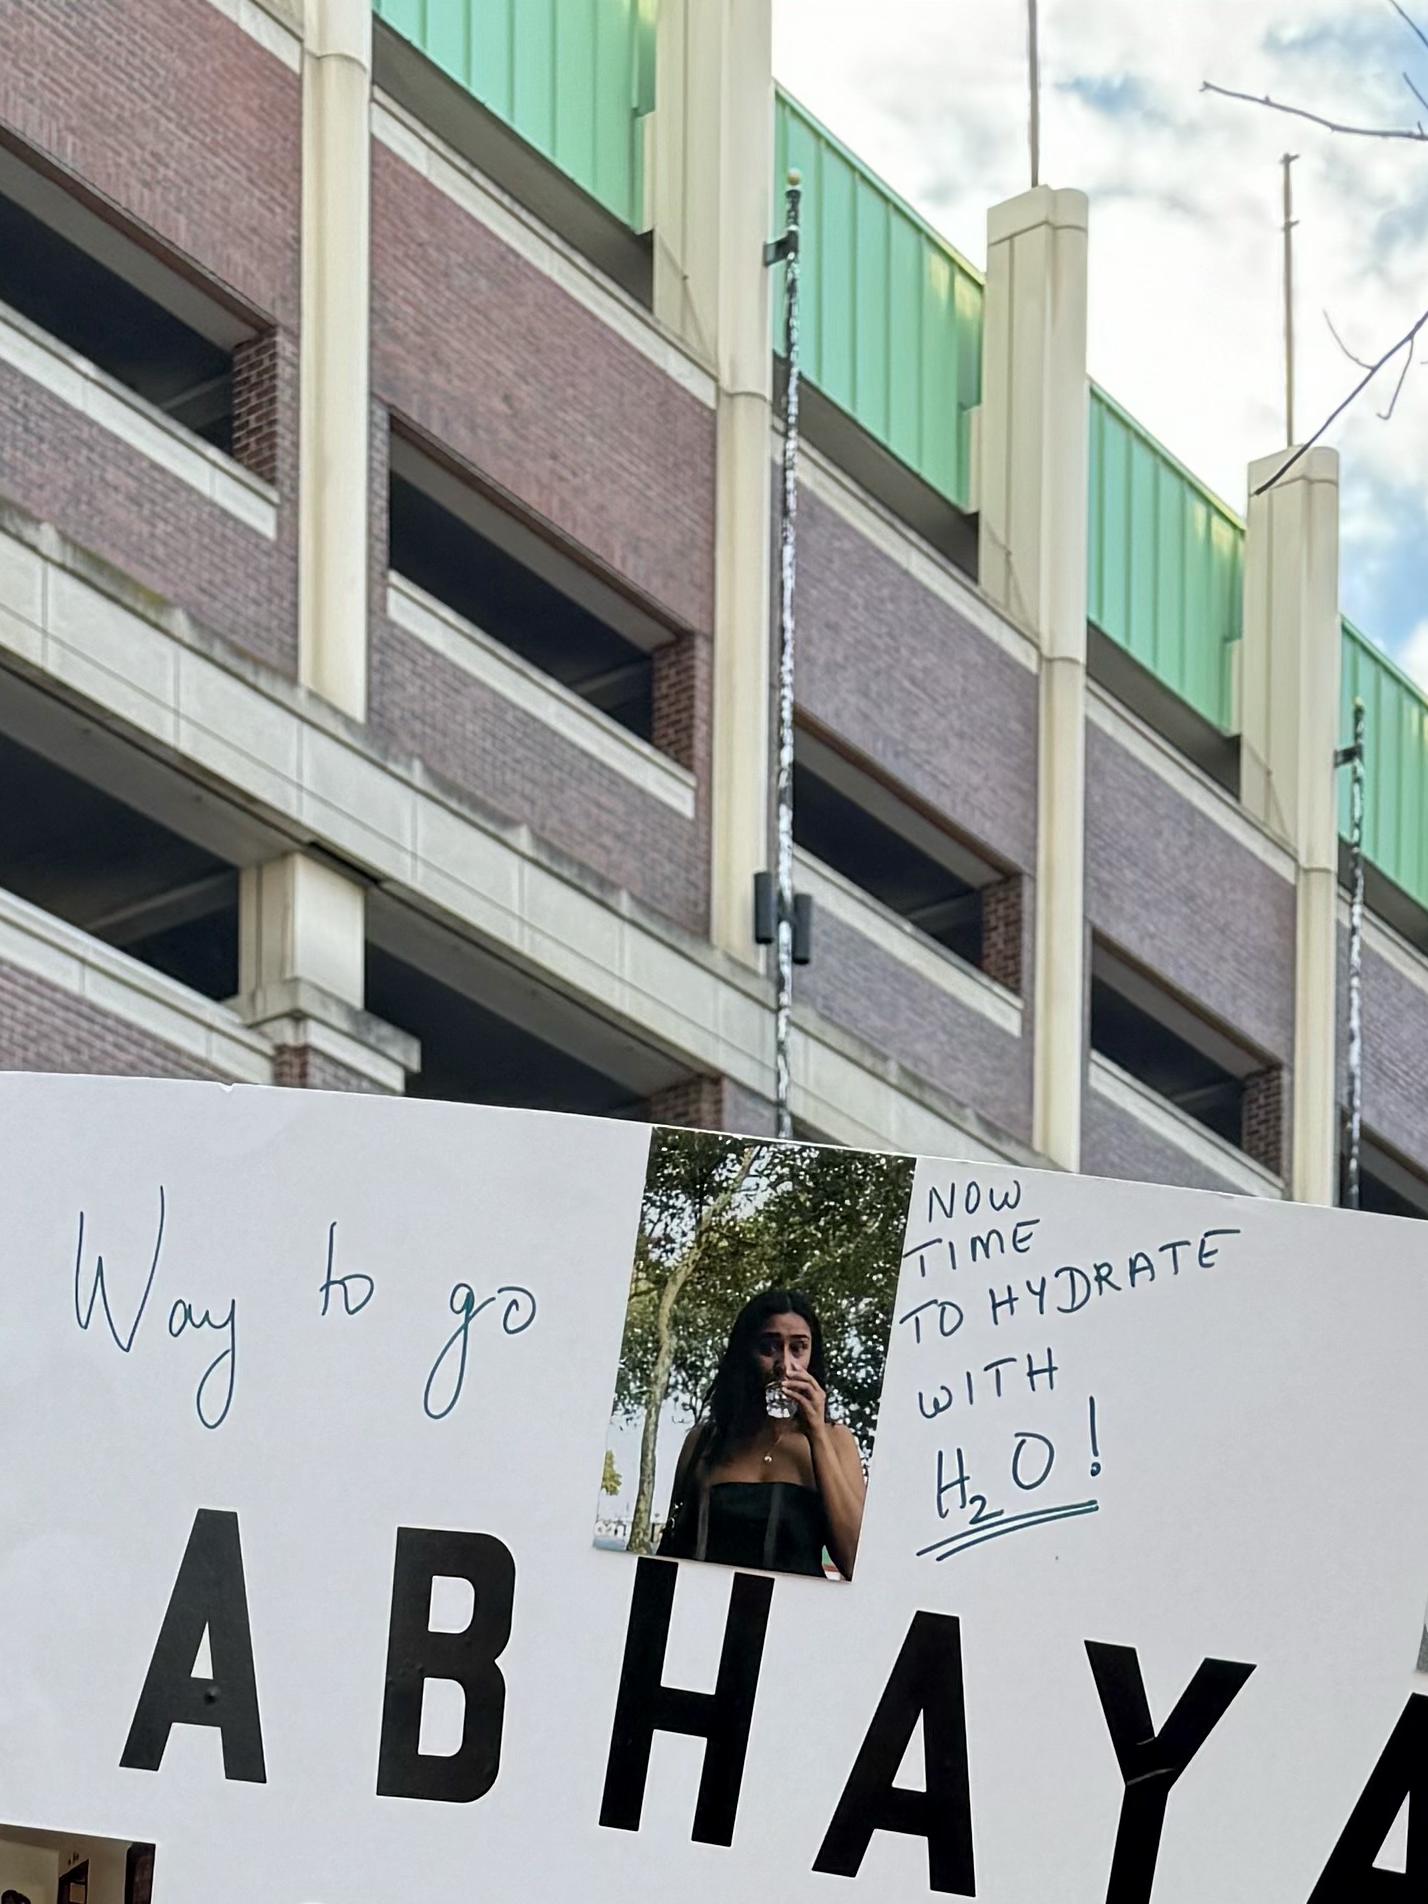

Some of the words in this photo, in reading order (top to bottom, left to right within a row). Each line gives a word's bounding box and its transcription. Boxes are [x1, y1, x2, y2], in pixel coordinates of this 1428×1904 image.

[928, 1180, 1022, 1223] NOW
[903, 1218, 1040, 1277] TIME
[75, 1185, 235, 1429] Way
[319, 1221, 375, 1317] to
[424, 1282, 537, 1419] go
[899, 1299, 964, 1344] TO
[988, 1229, 1241, 1325] HYDRATE
[918, 1347, 1058, 1419] WITH
